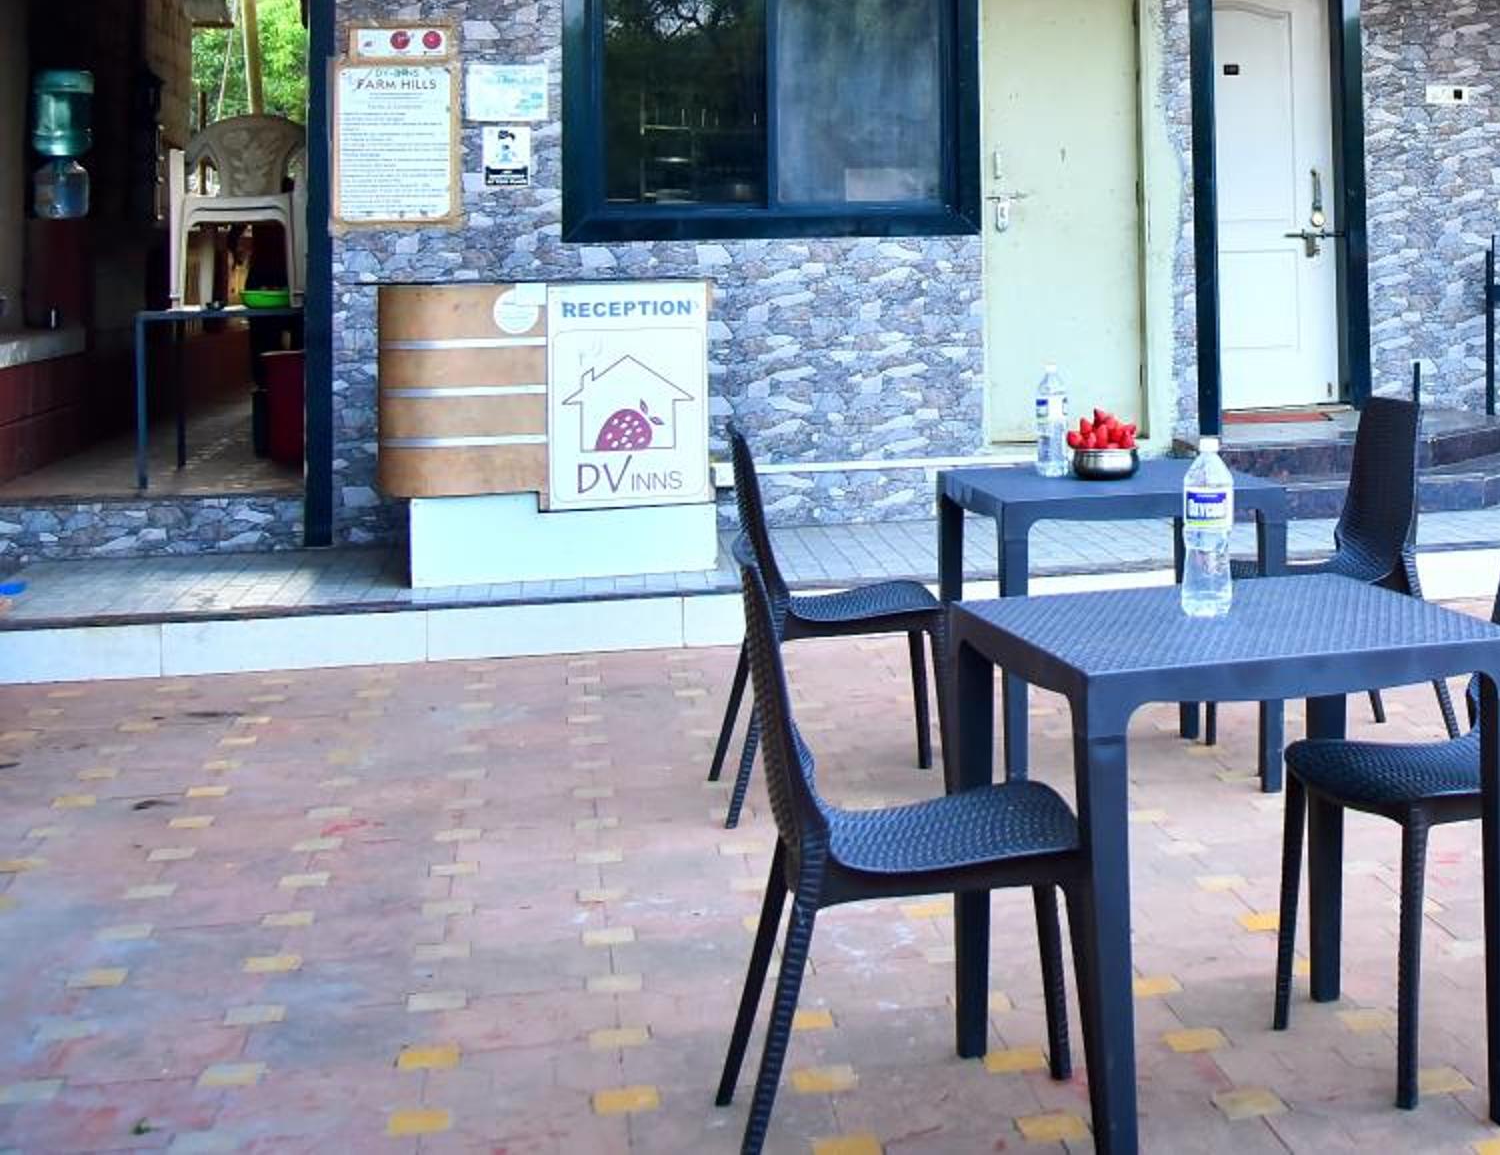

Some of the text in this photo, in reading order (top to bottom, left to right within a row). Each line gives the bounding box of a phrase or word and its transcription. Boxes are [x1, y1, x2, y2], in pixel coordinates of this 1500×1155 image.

[356, 79, 437, 90] FARM HILLS
[562, 300, 692, 317] RECEPTION
[577, 454, 683, 493] DV INNS
